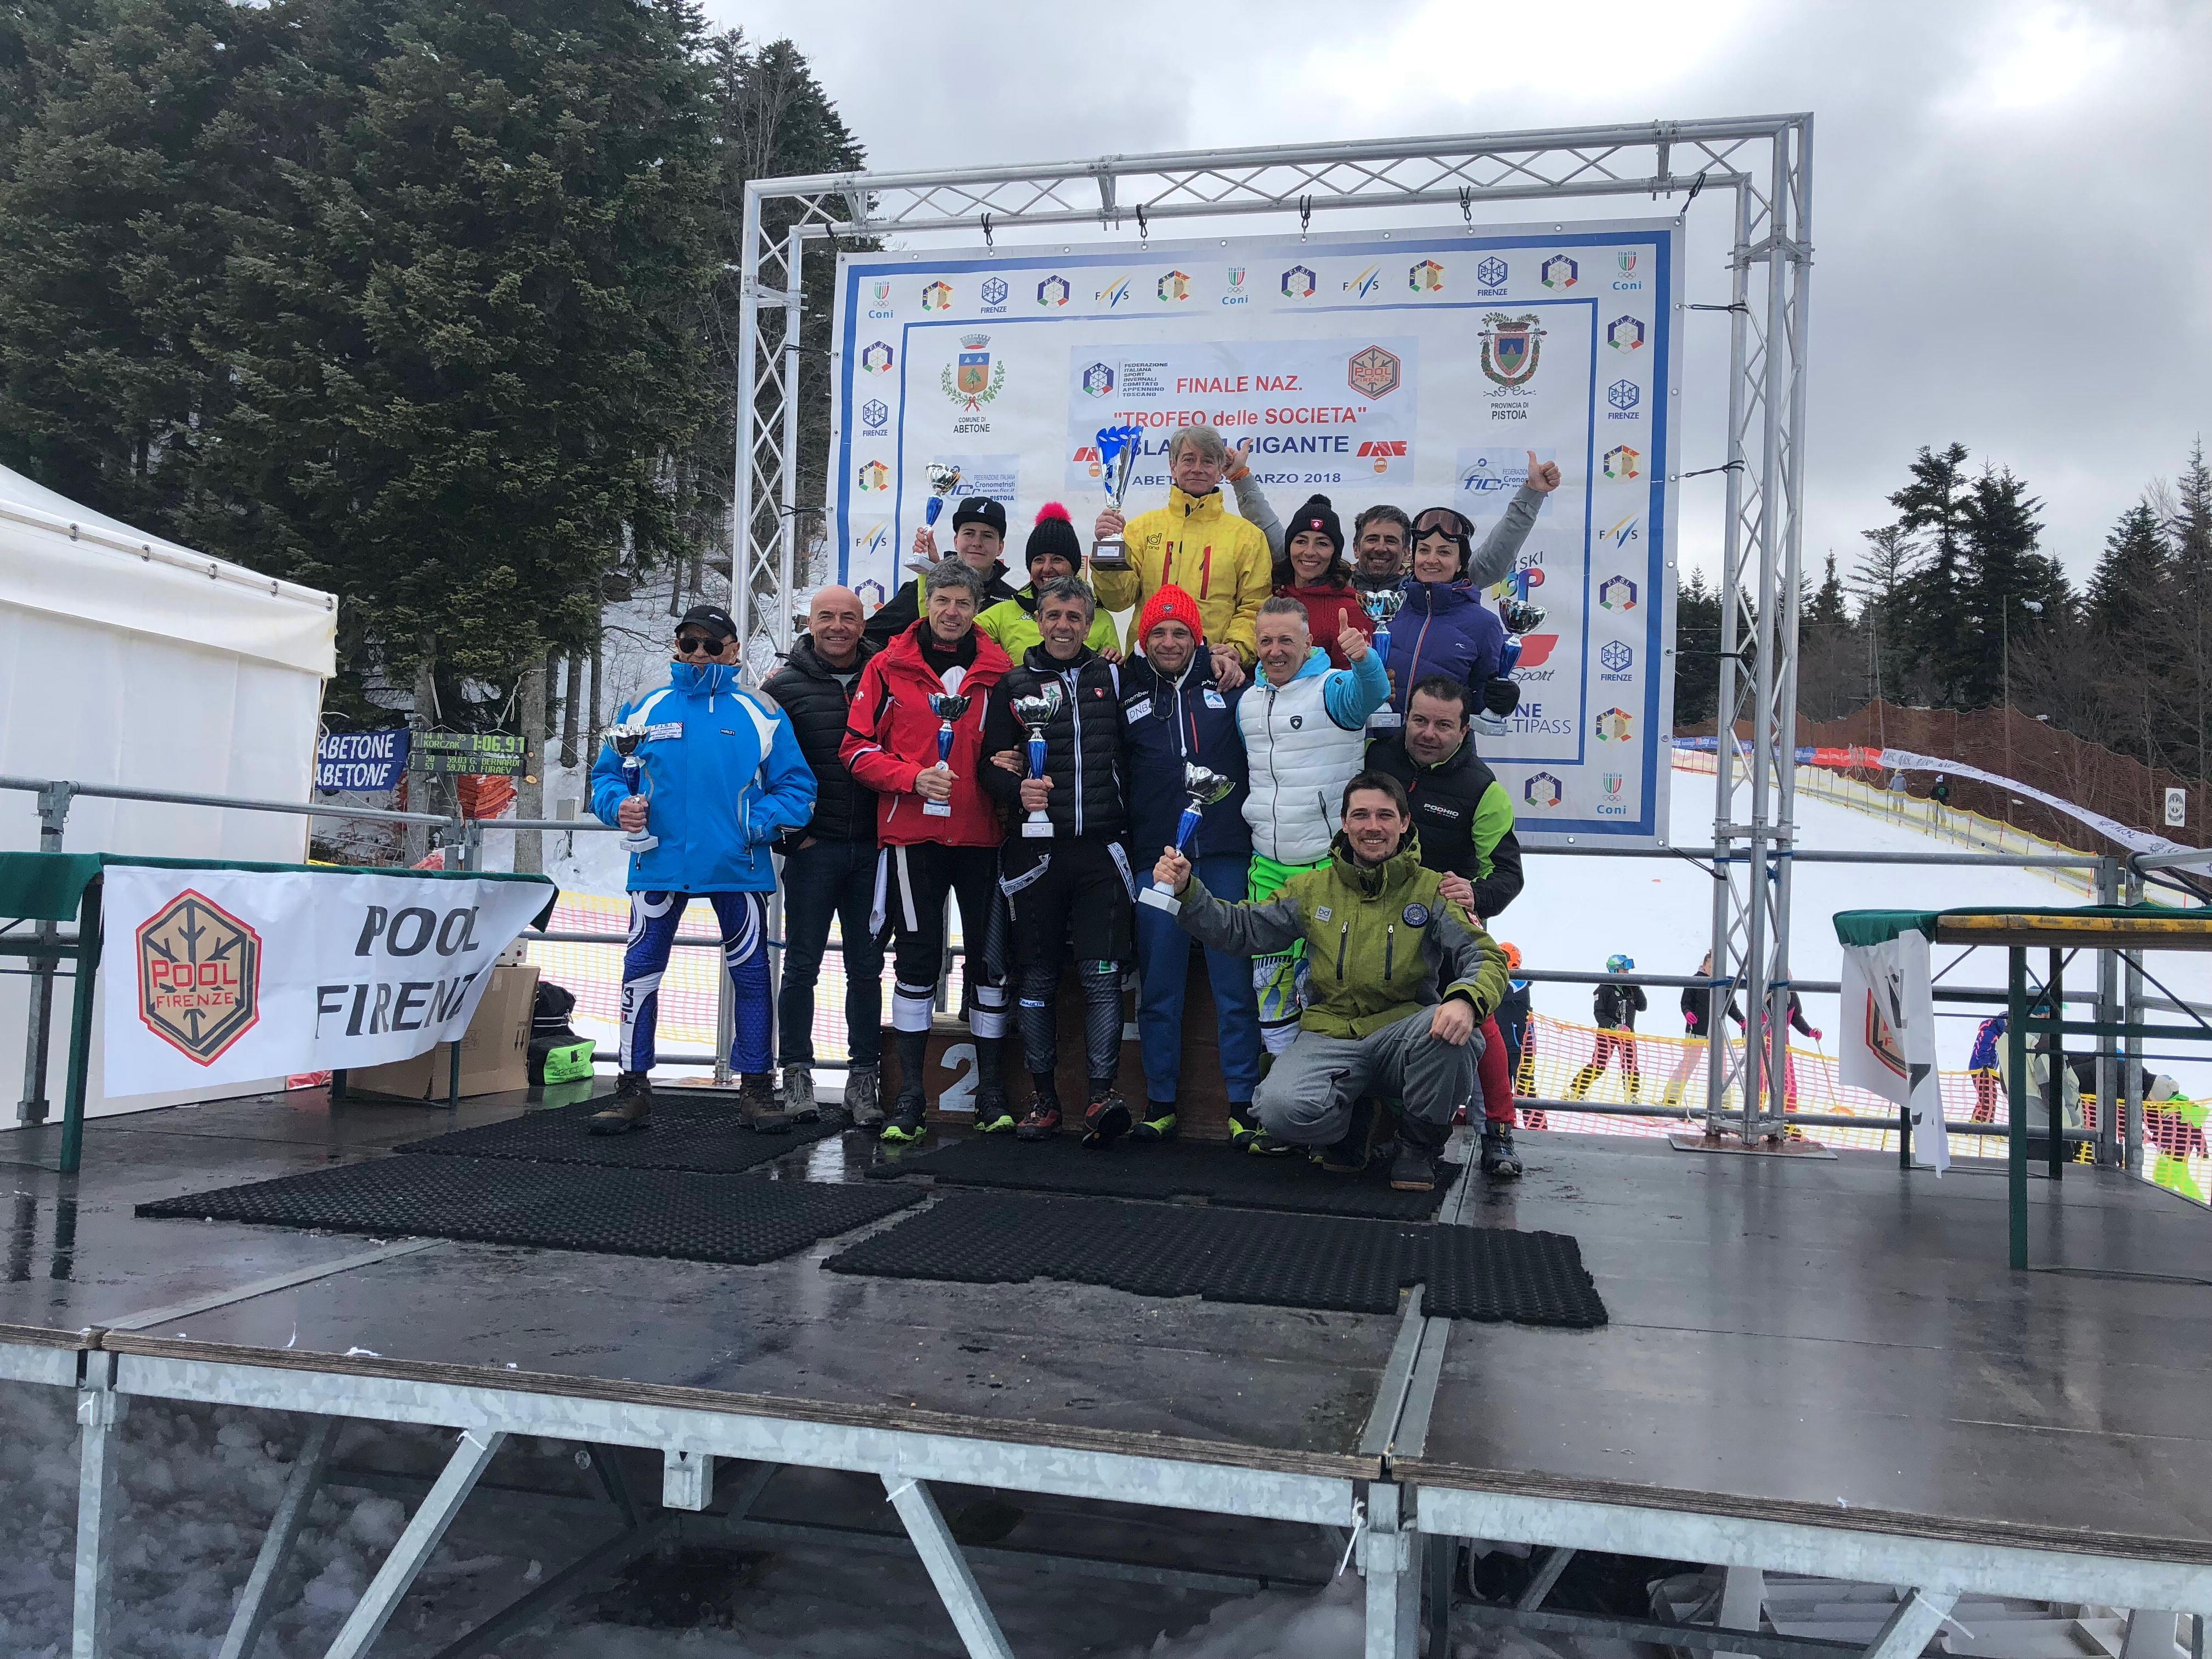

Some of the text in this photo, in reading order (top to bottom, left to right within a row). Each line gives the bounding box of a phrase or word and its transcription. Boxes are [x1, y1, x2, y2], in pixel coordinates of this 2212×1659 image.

[1612, 281, 1642, 290] Coni
[1222, 295, 1249, 304] Coni
[868, 309, 894, 319] Coni
[980, 306, 1007, 314] FIRENZE
[1089, 364, 1108, 374] FISI
[1354, 367, 1392, 376] POOL
[1176, 375, 1303, 394] FINALE NAZ.
[1212, 409, 1259, 426] delle
[1492, 410, 1527, 420] PISTOIA
[953, 424, 991, 433] ABETONE
[1254, 473, 1299, 484] ARZO
[1304, 473, 1341, 483] 2018
[1519, 550, 1543, 570] SKI
[1509, 667, 1555, 684] Sport
[1600, 674, 1633, 682] FIRENZE
[1125, 690, 1149, 705] member
[1129, 703, 1148, 719] DNB
[318, 733, 396, 759] ABETONE
[423, 740, 460, 749] KORCZAK
[471, 734, 525, 754] 1:06.91
[447, 756, 467, 764] 59.03
[469, 757, 477, 765] G.
[481, 758, 520, 767] BERNARDI
[315, 763, 392, 787] ABETONE
[1596, 804, 1627, 815] Coni
[1318, 907, 1330, 917] bd
[354, 905, 480, 957] POOL
[151, 960, 238, 988] POOL
[156, 992, 234, 1008] FIRENZE
[315, 972, 479, 1039] FIRENZ
[620, 986, 634, 1024] FILA
[939, 1043, 980, 1112] 2
